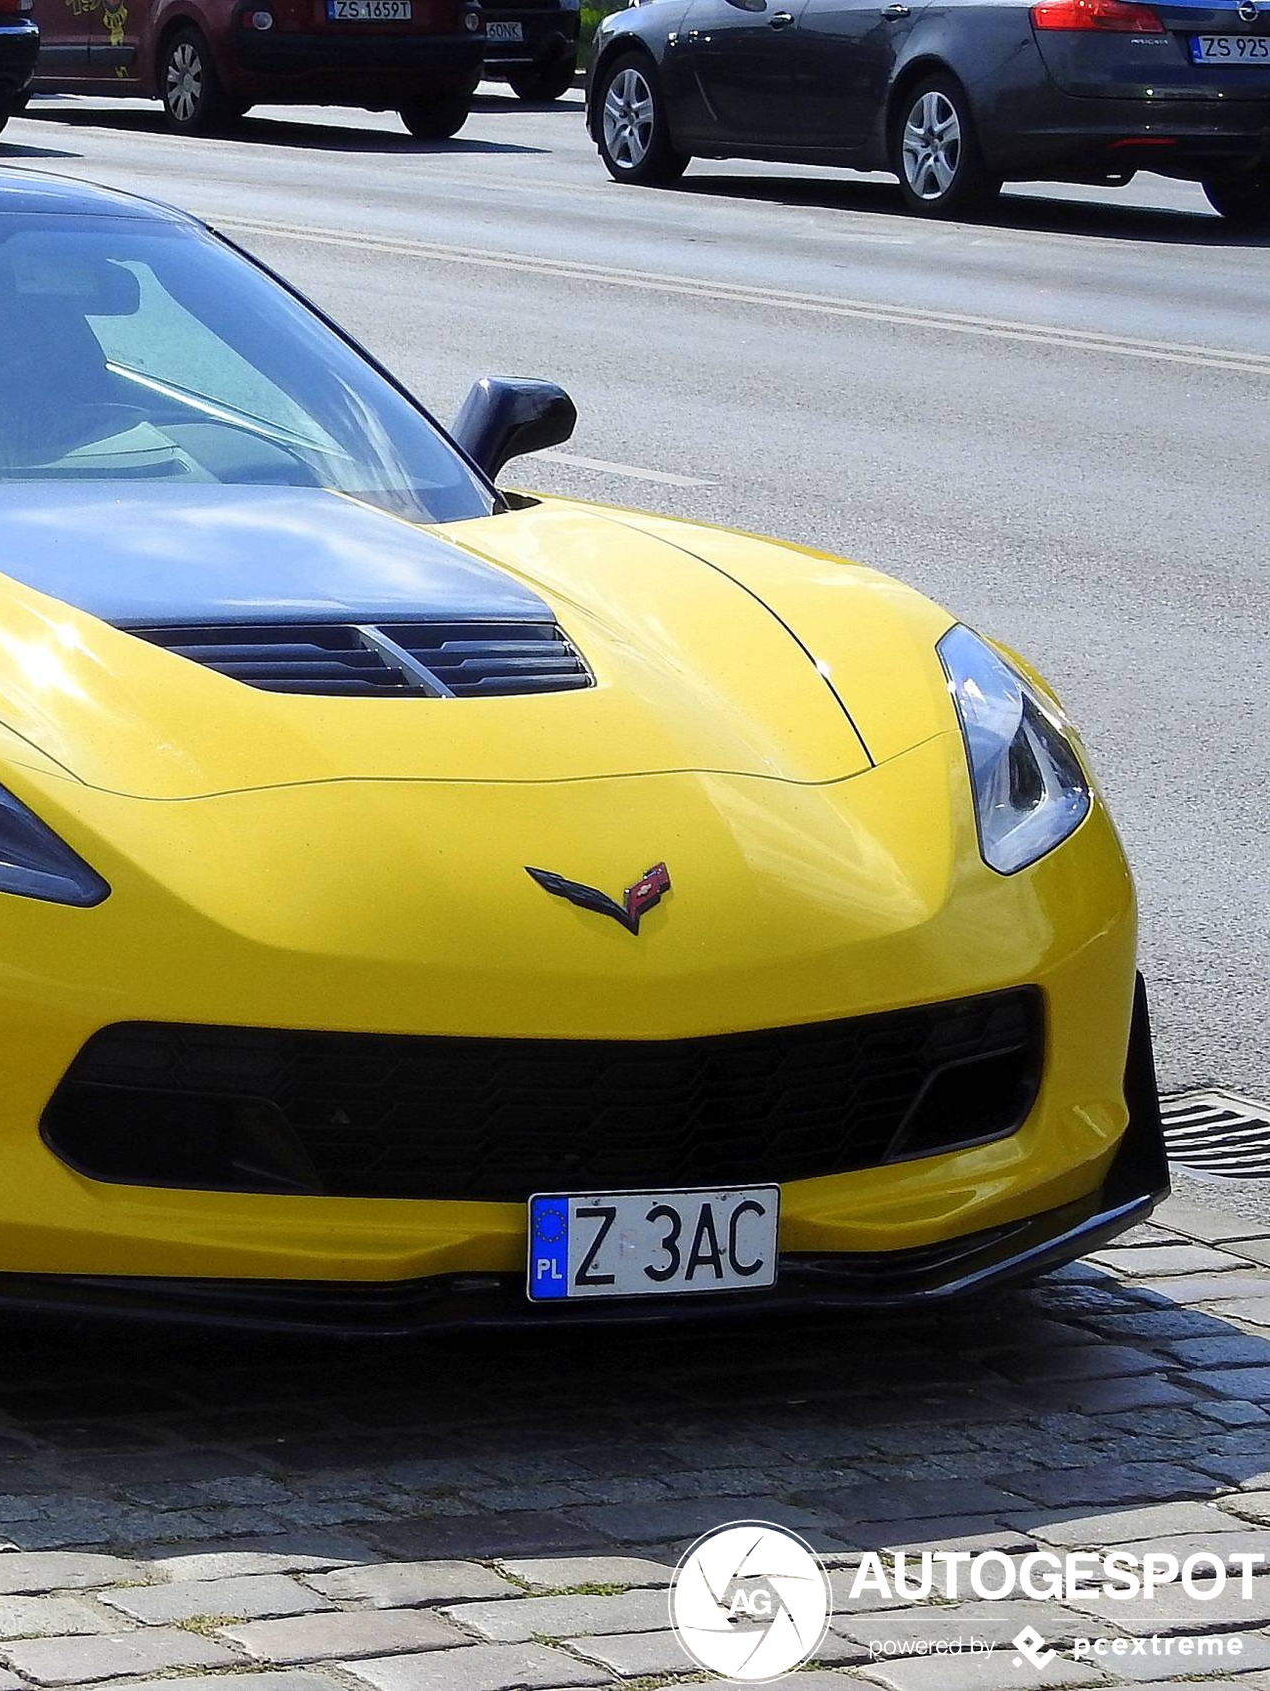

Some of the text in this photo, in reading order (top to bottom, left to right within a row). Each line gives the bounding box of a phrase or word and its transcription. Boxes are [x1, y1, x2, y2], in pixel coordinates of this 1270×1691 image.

[336, 1, 408, 17] ZS 1659T
[1202, 38, 1231, 57] ZS
[574, 1200, 766, 1286] Z 3AC
[536, 1258, 563, 1280] PL
